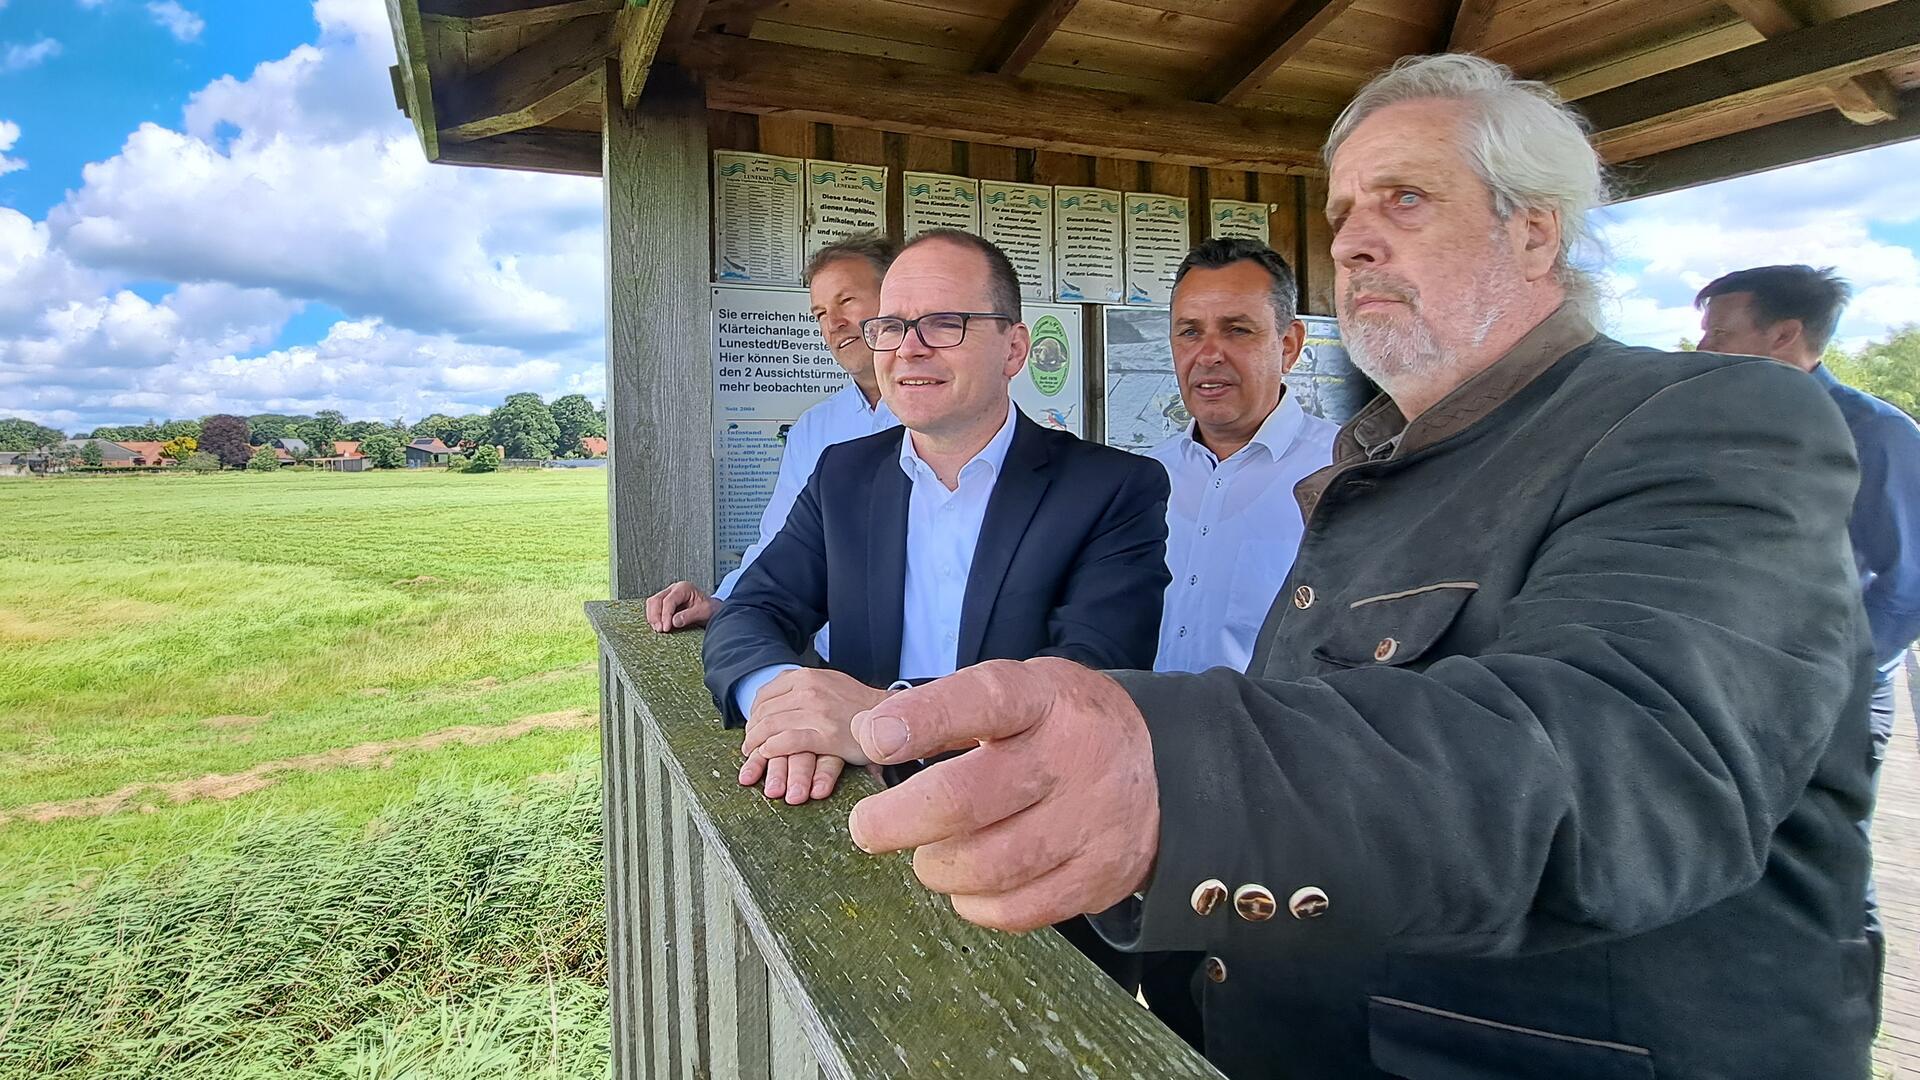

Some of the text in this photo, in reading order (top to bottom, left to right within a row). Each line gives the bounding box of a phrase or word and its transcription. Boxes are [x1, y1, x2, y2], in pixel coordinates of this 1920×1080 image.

[843, 196, 875, 205] Sandplätze
[719, 309, 738, 319] Sie
[740, 310, 796, 322] erreichen
[719, 323, 811, 338] Klärteichanlage
[719, 338, 831, 352] Lunestedt/Beverste
[719, 352, 833, 365] Hier können Sie den
[719, 367, 850, 379] den 2 Aussichtstürmen
[719, 382, 844, 393] mehr beobachten und
